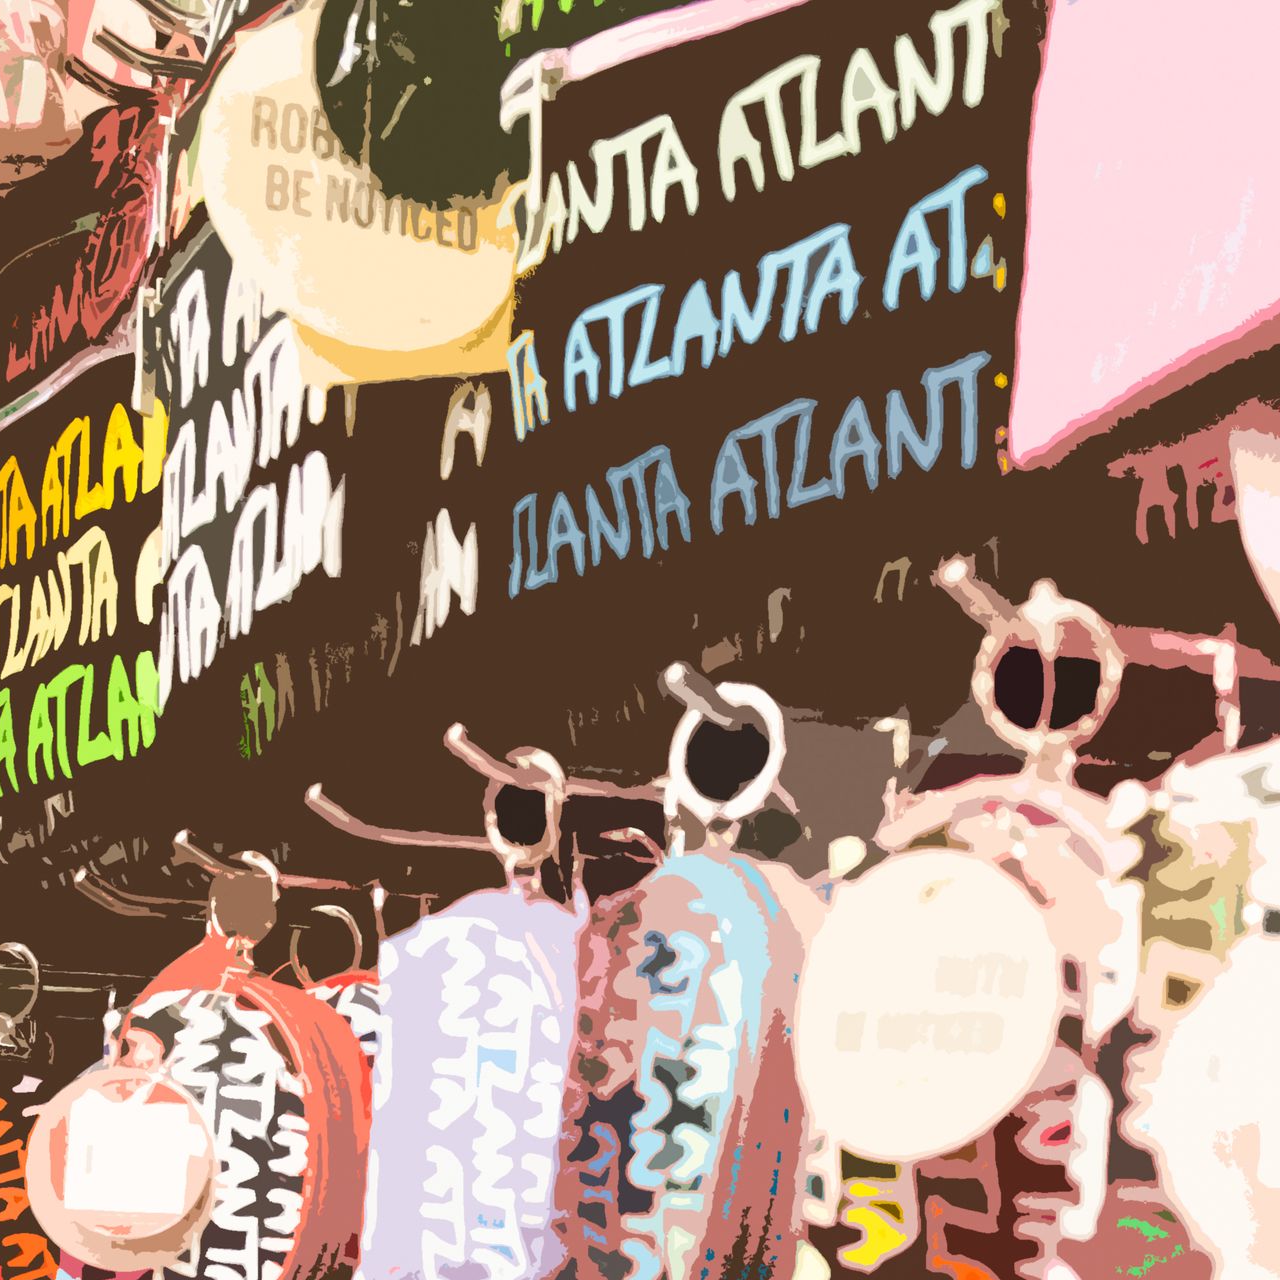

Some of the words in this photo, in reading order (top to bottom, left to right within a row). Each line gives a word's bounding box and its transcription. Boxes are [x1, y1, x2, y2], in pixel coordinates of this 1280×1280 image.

[265, 164, 314, 218] BE
[718, 0, 1005, 202] ATLANT
[563, 223, 864, 413] ATLANTA
